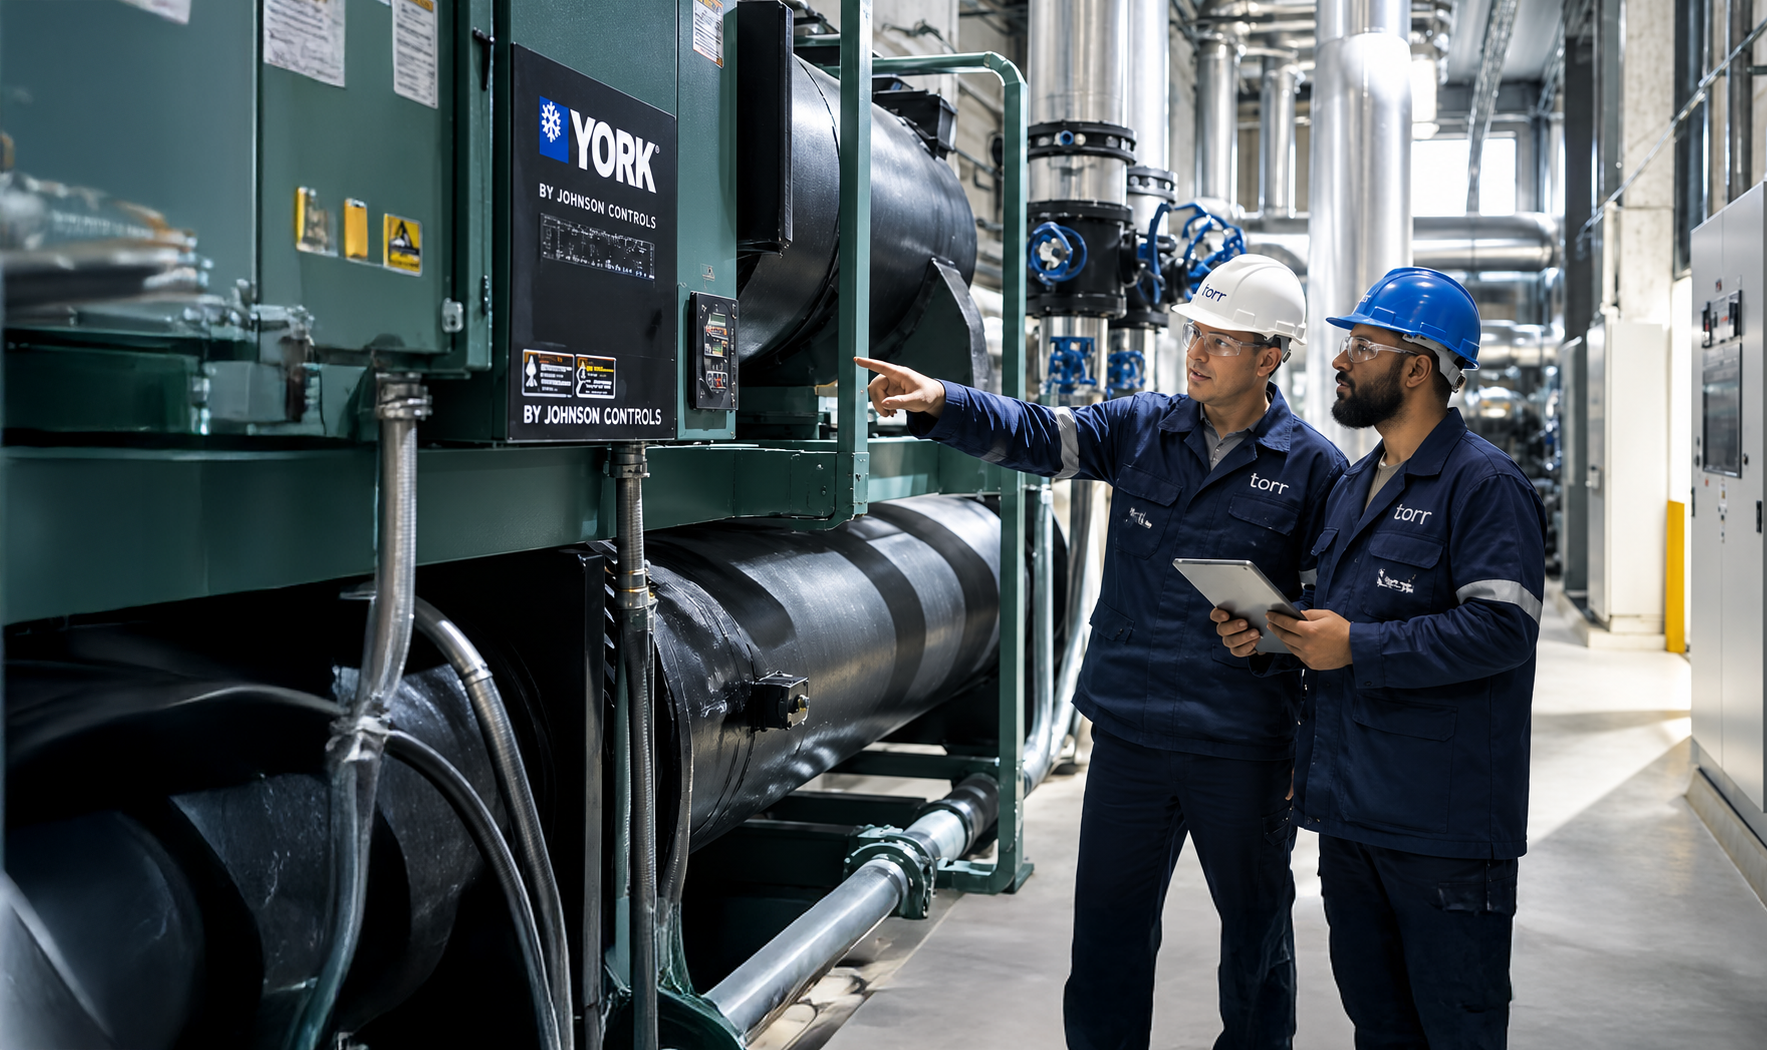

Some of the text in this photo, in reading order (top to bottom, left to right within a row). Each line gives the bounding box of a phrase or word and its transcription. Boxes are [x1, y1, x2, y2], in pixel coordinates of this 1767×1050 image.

[539, 182, 657, 229] BY JOHNSON CONTROLS
[1201, 283, 1228, 302] torr
[523, 404, 662, 426] BY JOHNSON CONTROLS
[1250, 472, 1290, 495] torr
[1393, 503, 1433, 525] torr
